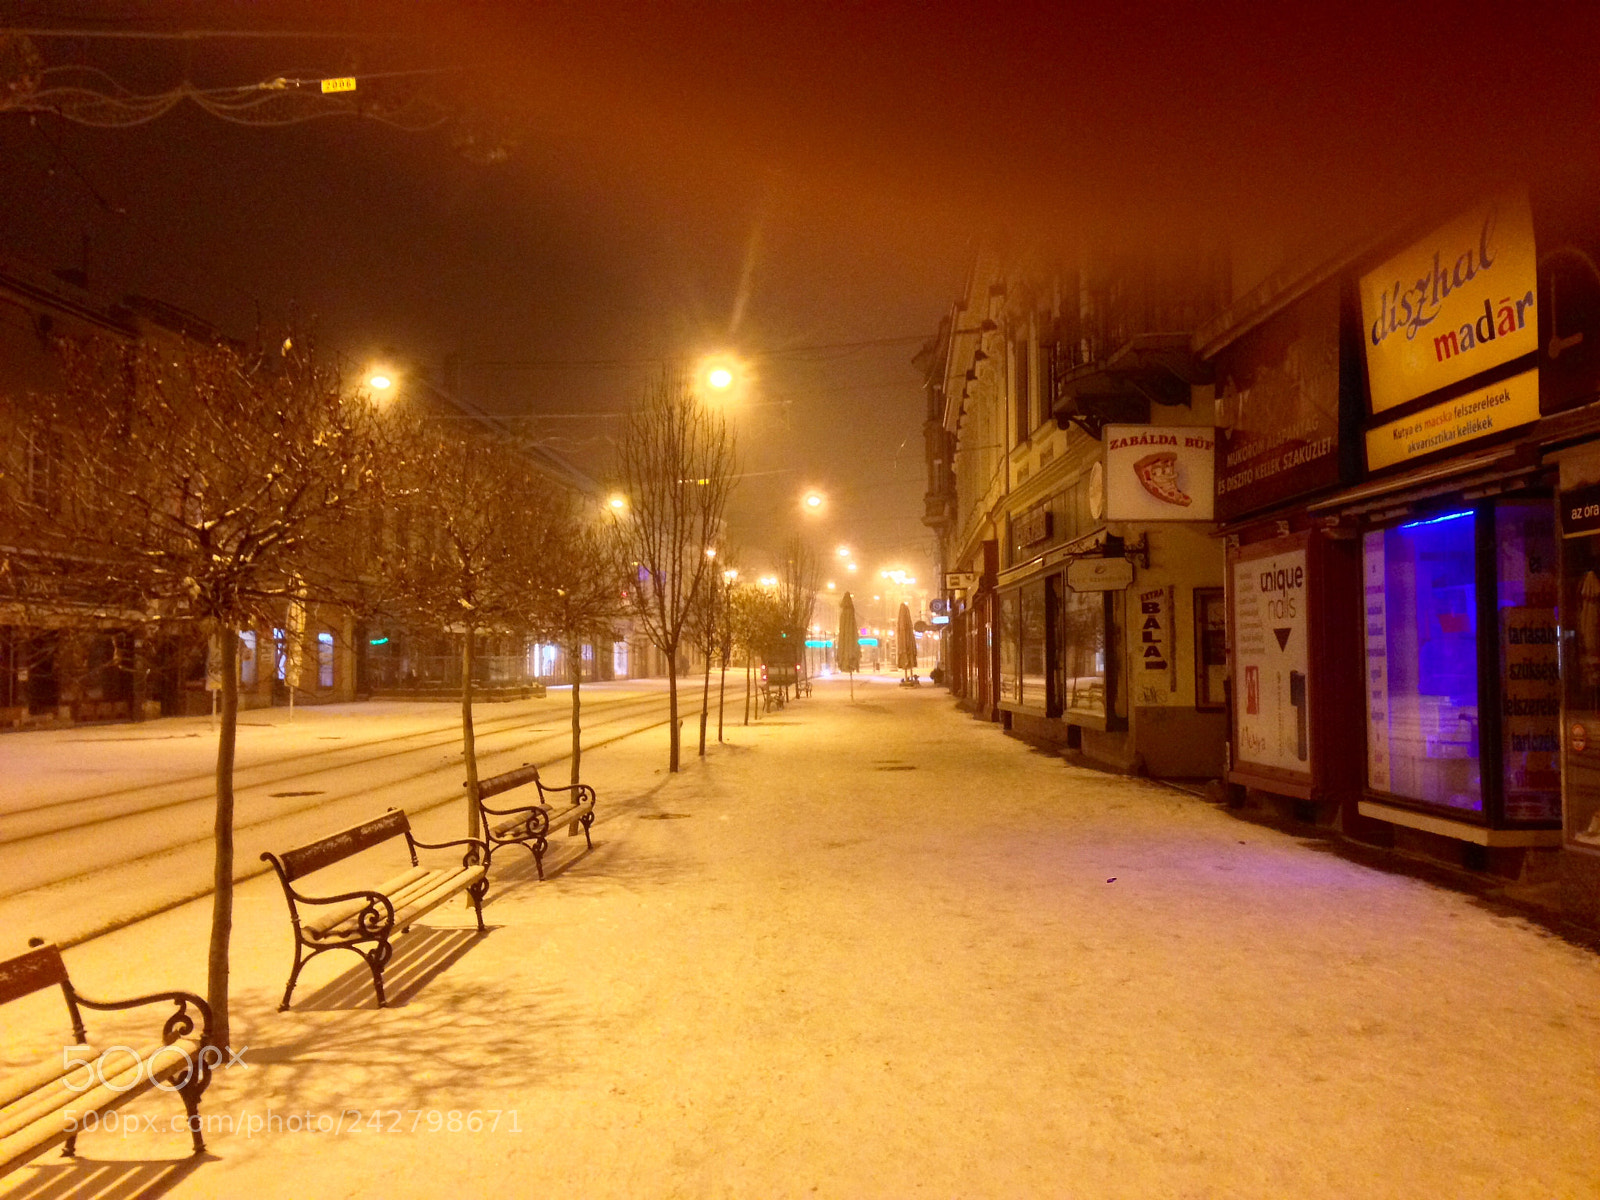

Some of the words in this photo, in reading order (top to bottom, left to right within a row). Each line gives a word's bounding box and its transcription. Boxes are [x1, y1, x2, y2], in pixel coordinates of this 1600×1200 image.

[1392, 426, 1413, 440] Kutya
[1424, 411, 1453, 429] macska
[1109, 431, 1178, 451] ZABÁLDA
[1571, 507, 1583, 520] az
[1261, 563, 1303, 598] unique
[1140, 588, 1164, 602] EXTRA
